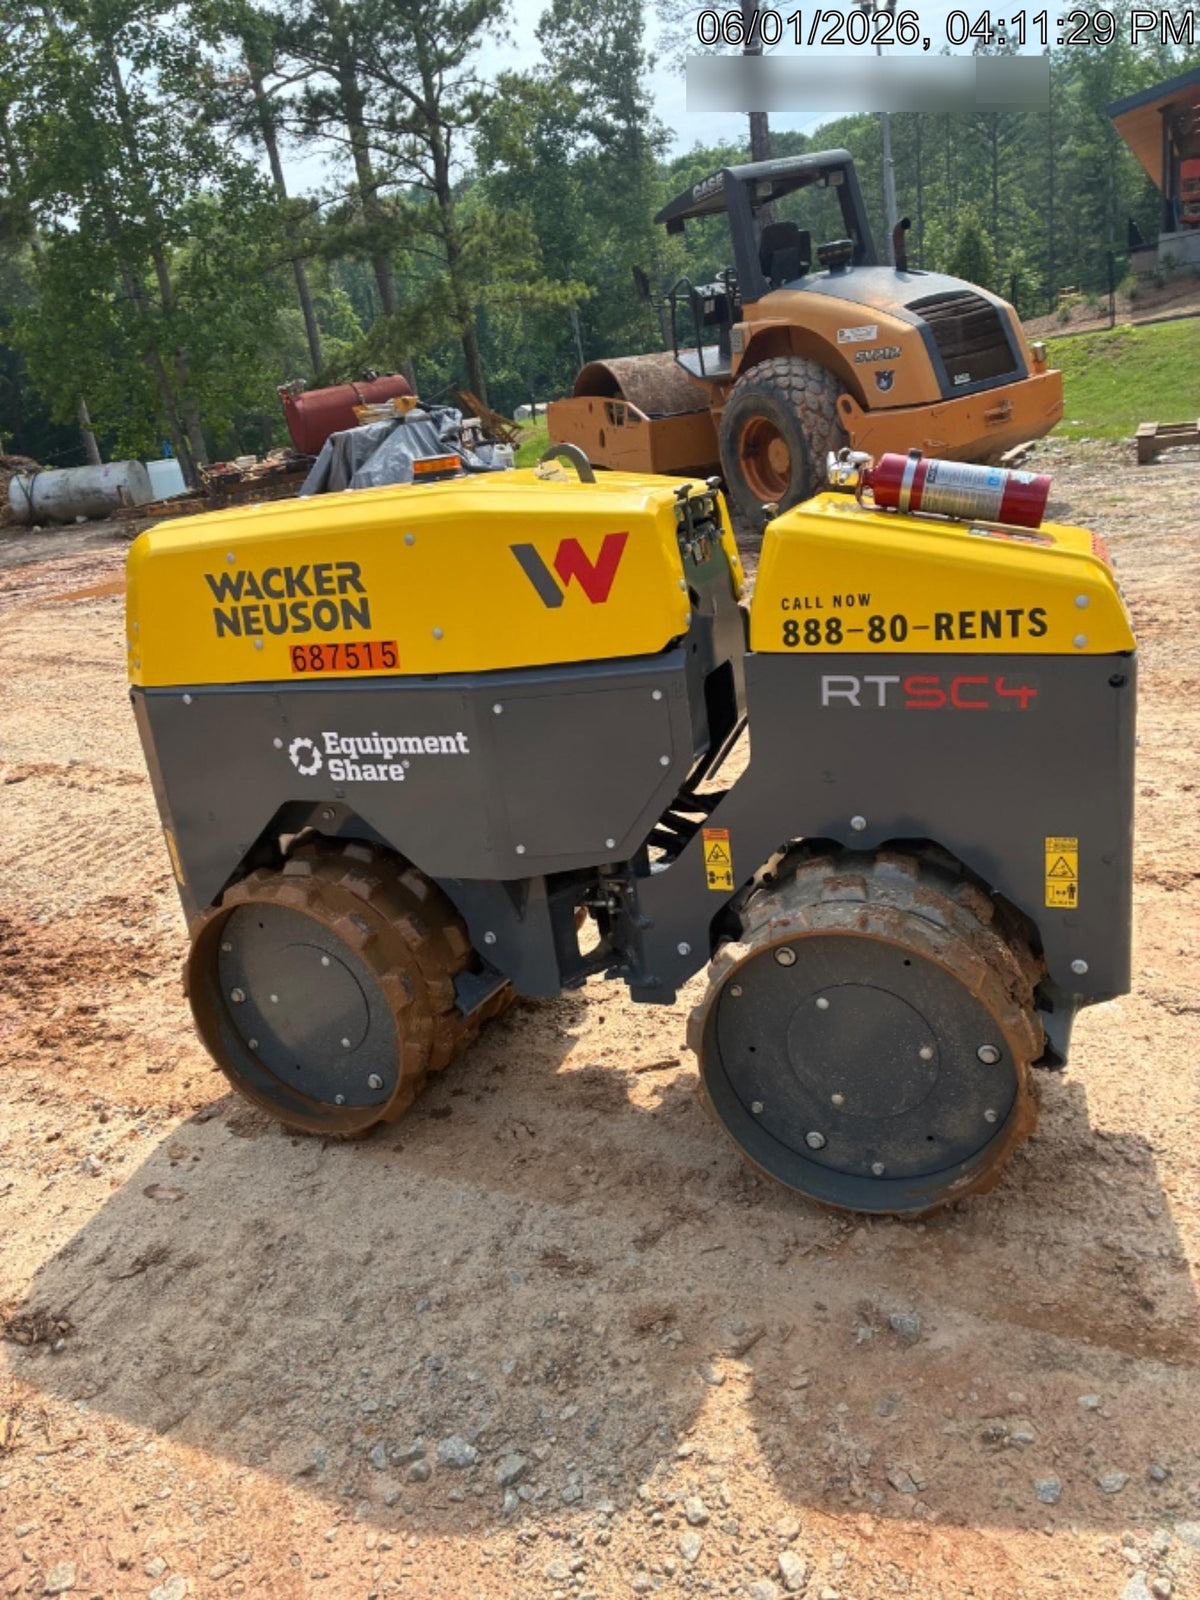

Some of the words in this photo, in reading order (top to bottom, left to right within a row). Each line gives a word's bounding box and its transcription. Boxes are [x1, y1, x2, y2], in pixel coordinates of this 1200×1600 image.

[204, 561, 367, 603] WACKER
[213, 597, 372, 638] NEUSON
[781, 596, 824, 611] CALL
[833, 593, 872, 609] NOW
[782, 607, 1049, 648] 888-80-RENTS
[291, 641, 397, 672] 687515
[821, 674, 1039, 710] RTSC4
[321, 731, 470, 760] Equipment
